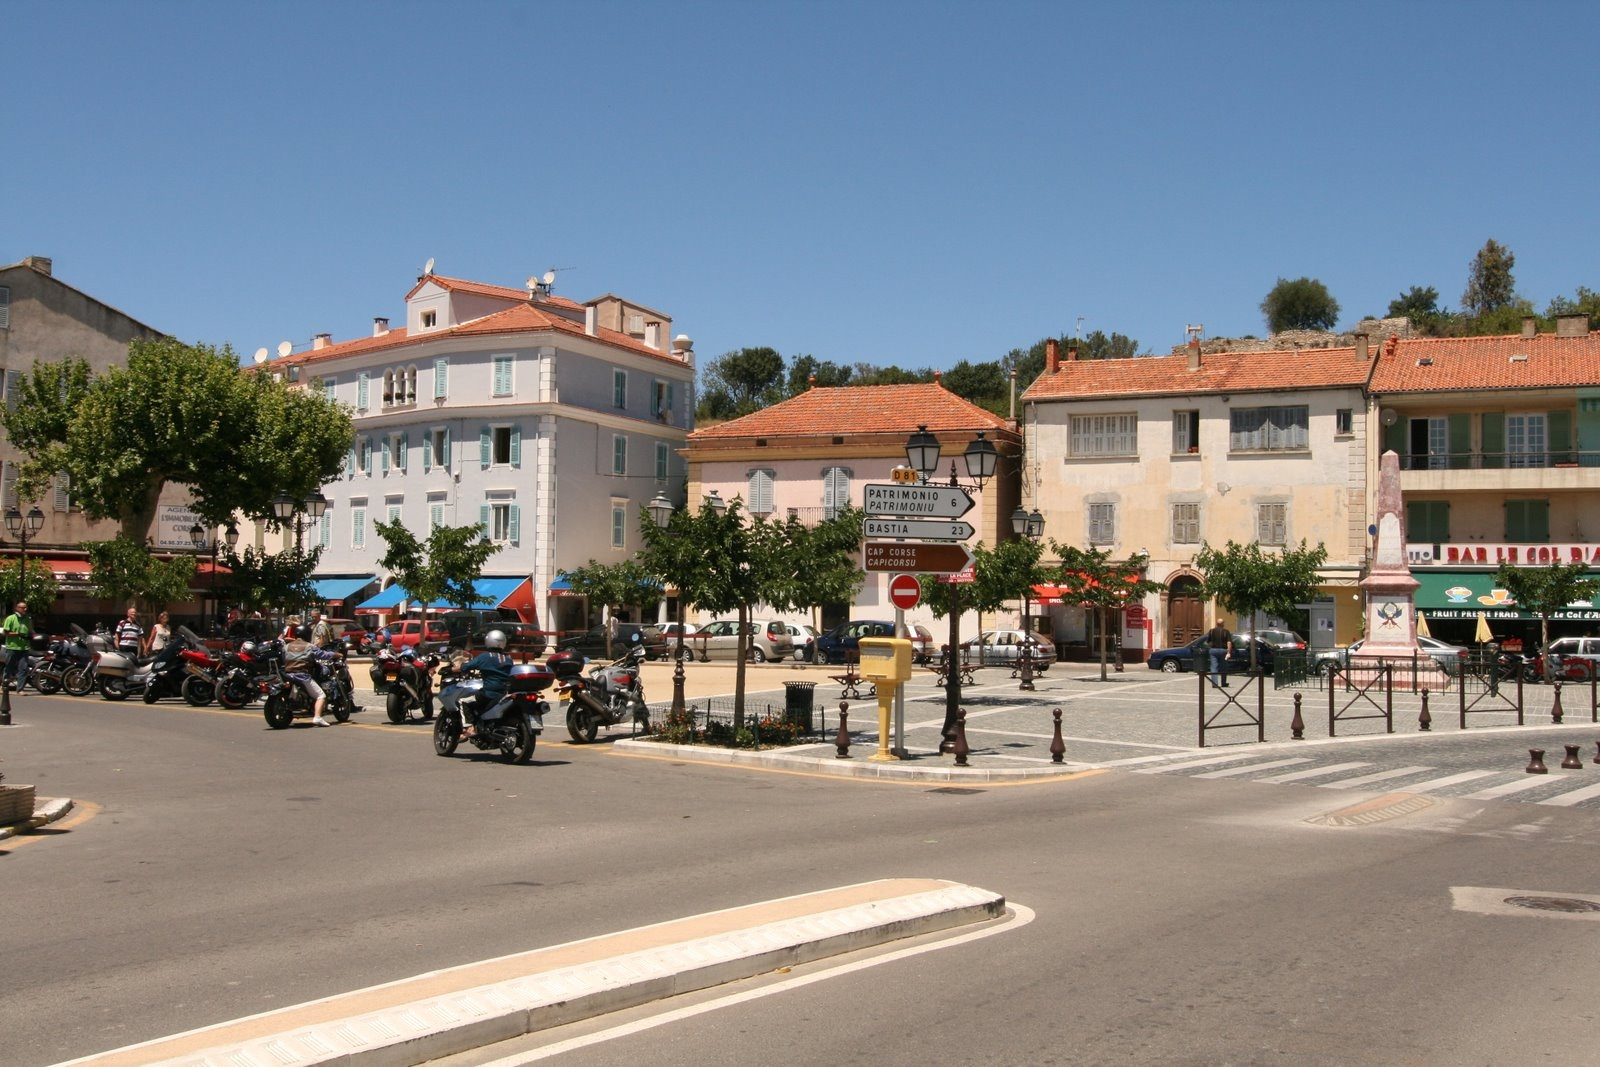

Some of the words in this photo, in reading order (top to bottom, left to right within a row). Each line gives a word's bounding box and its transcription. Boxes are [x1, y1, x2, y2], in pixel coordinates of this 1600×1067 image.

[894, 470, 900, 479] D
[903, 471, 916, 480] 81
[868, 489, 939, 501] PATRIMONIO
[951, 498, 957, 507] 6
[869, 501, 935, 512] PATRIMONIU
[868, 523, 909, 534] BASTIA
[951, 526, 964, 535] 23
[867, 548, 884, 556] CAP
[889, 548, 917, 557] CORSE
[1447, 547, 1487, 561] BAR
[1496, 547, 1518, 561] LE
[1526, 547, 1562, 561] COL
[867, 557, 917, 567] CAPICORSU
[1432, 610, 1458, 618] FRUIT
